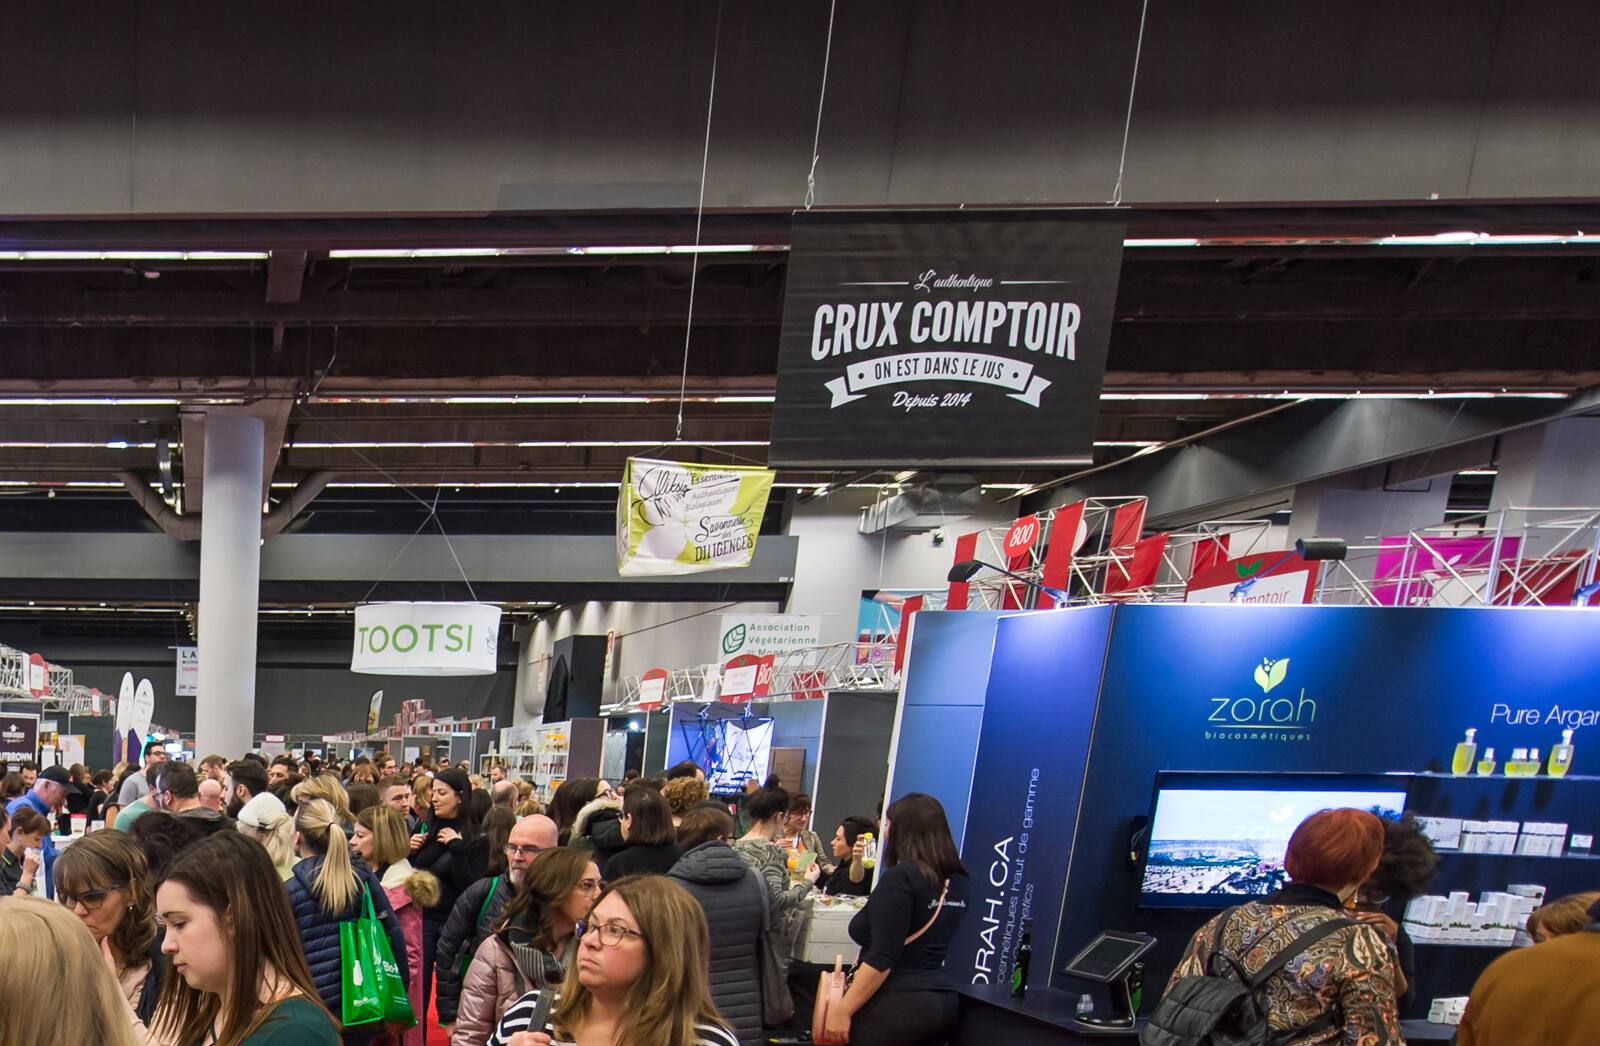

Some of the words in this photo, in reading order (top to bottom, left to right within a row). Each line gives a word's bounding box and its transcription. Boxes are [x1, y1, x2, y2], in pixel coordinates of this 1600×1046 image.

[913, 269, 993, 293] L'authentique
[811, 302, 903, 361] CRUX
[910, 300, 1081, 361] COMPTOIR
[874, 361, 891, 380] ON
[896, 358, 919, 376] EST
[924, 358, 958, 375] DANS
[963, 358, 977, 375] LE
[980, 359, 1005, 380] JUS
[892, 391, 937, 412] Depuis
[941, 392, 972, 407] 2014
[695, 533, 754, 562] DILIGENCES
[1009, 523, 1035, 548] 800
[358, 624, 473, 654] TOOTSI
[749, 623, 810, 632] Association
[749, 635, 817, 645] Végétarienne
[757, 662, 772, 686] Bio
[1207, 688, 1317, 722] zorah
[1490, 703, 1540, 725] Pure
[1204, 731, 1311, 742] biocosmétiques
[1023, 768, 1040, 828] gamme
[1018, 832, 1030, 854] de
[1010, 858, 1025, 892] haut
[997, 895, 1019, 984] osmétiques
